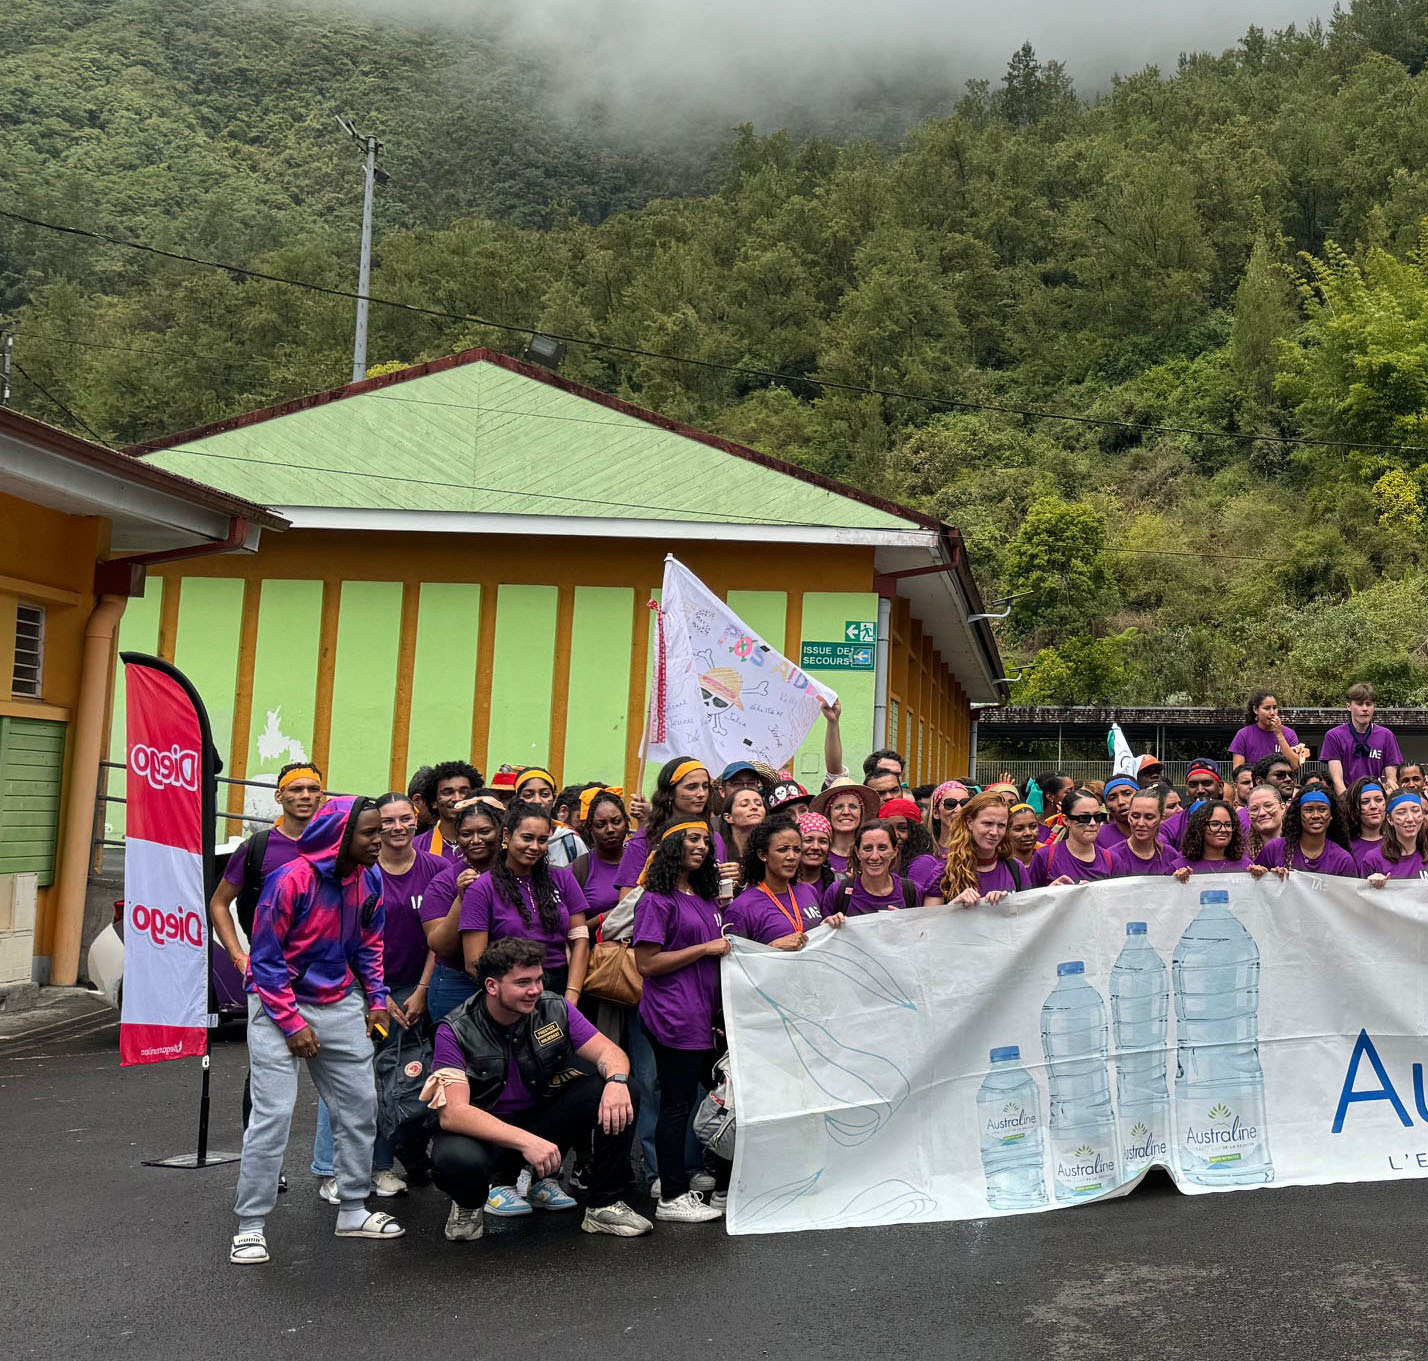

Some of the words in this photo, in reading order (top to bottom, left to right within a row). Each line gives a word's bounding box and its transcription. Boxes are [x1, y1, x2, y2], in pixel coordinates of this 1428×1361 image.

[803, 646, 833, 655] ISSUE
[836, 647, 850, 656] DE
[803, 656, 850, 666] SECOURS
[1368, 748, 1383, 760] IAE
[803, 906, 822, 920] IAE
[986, 1106, 1037, 1131] Australine
[1186, 1115, 1257, 1144] Australine
[1057, 1152, 1115, 1177] Australine
